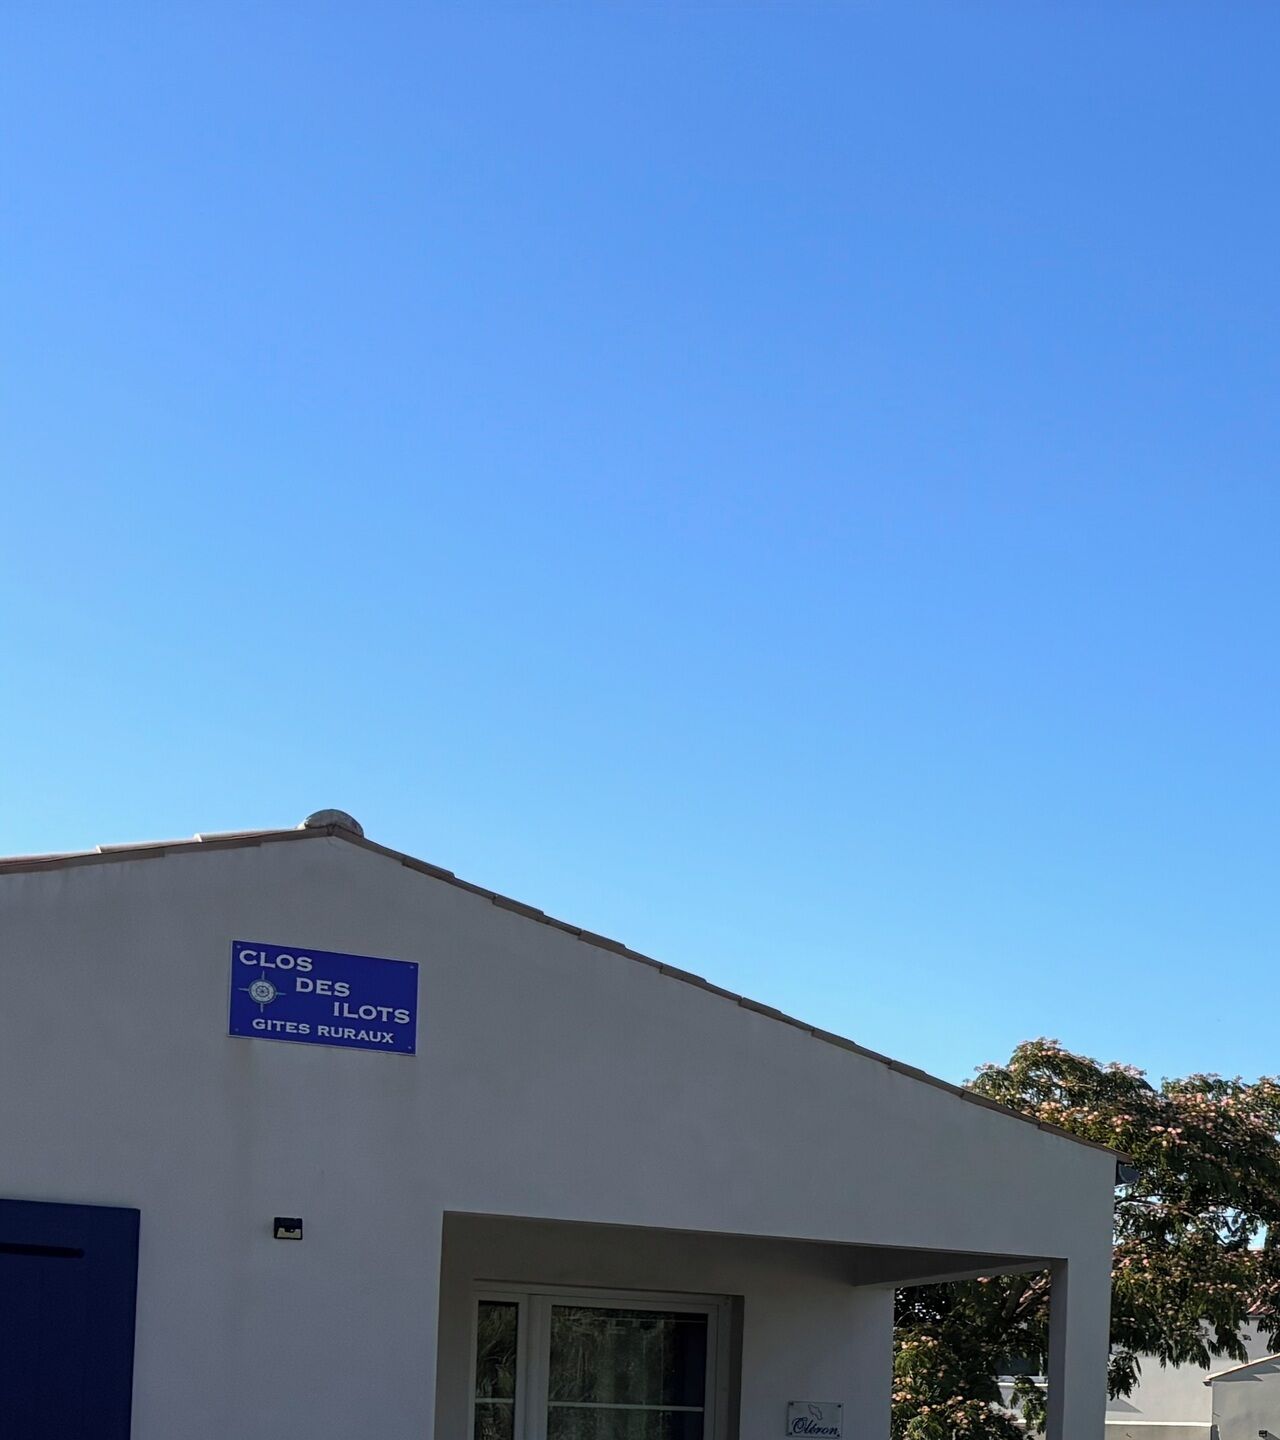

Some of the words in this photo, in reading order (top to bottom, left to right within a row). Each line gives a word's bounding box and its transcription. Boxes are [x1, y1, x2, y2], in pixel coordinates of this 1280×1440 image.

[239, 950, 313, 972] CLOS
[296, 977, 351, 997] DES
[333, 1001, 410, 1024] ILOTS
[252, 1018, 310, 1034] GITES
[317, 1025, 394, 1043] RURAUX
